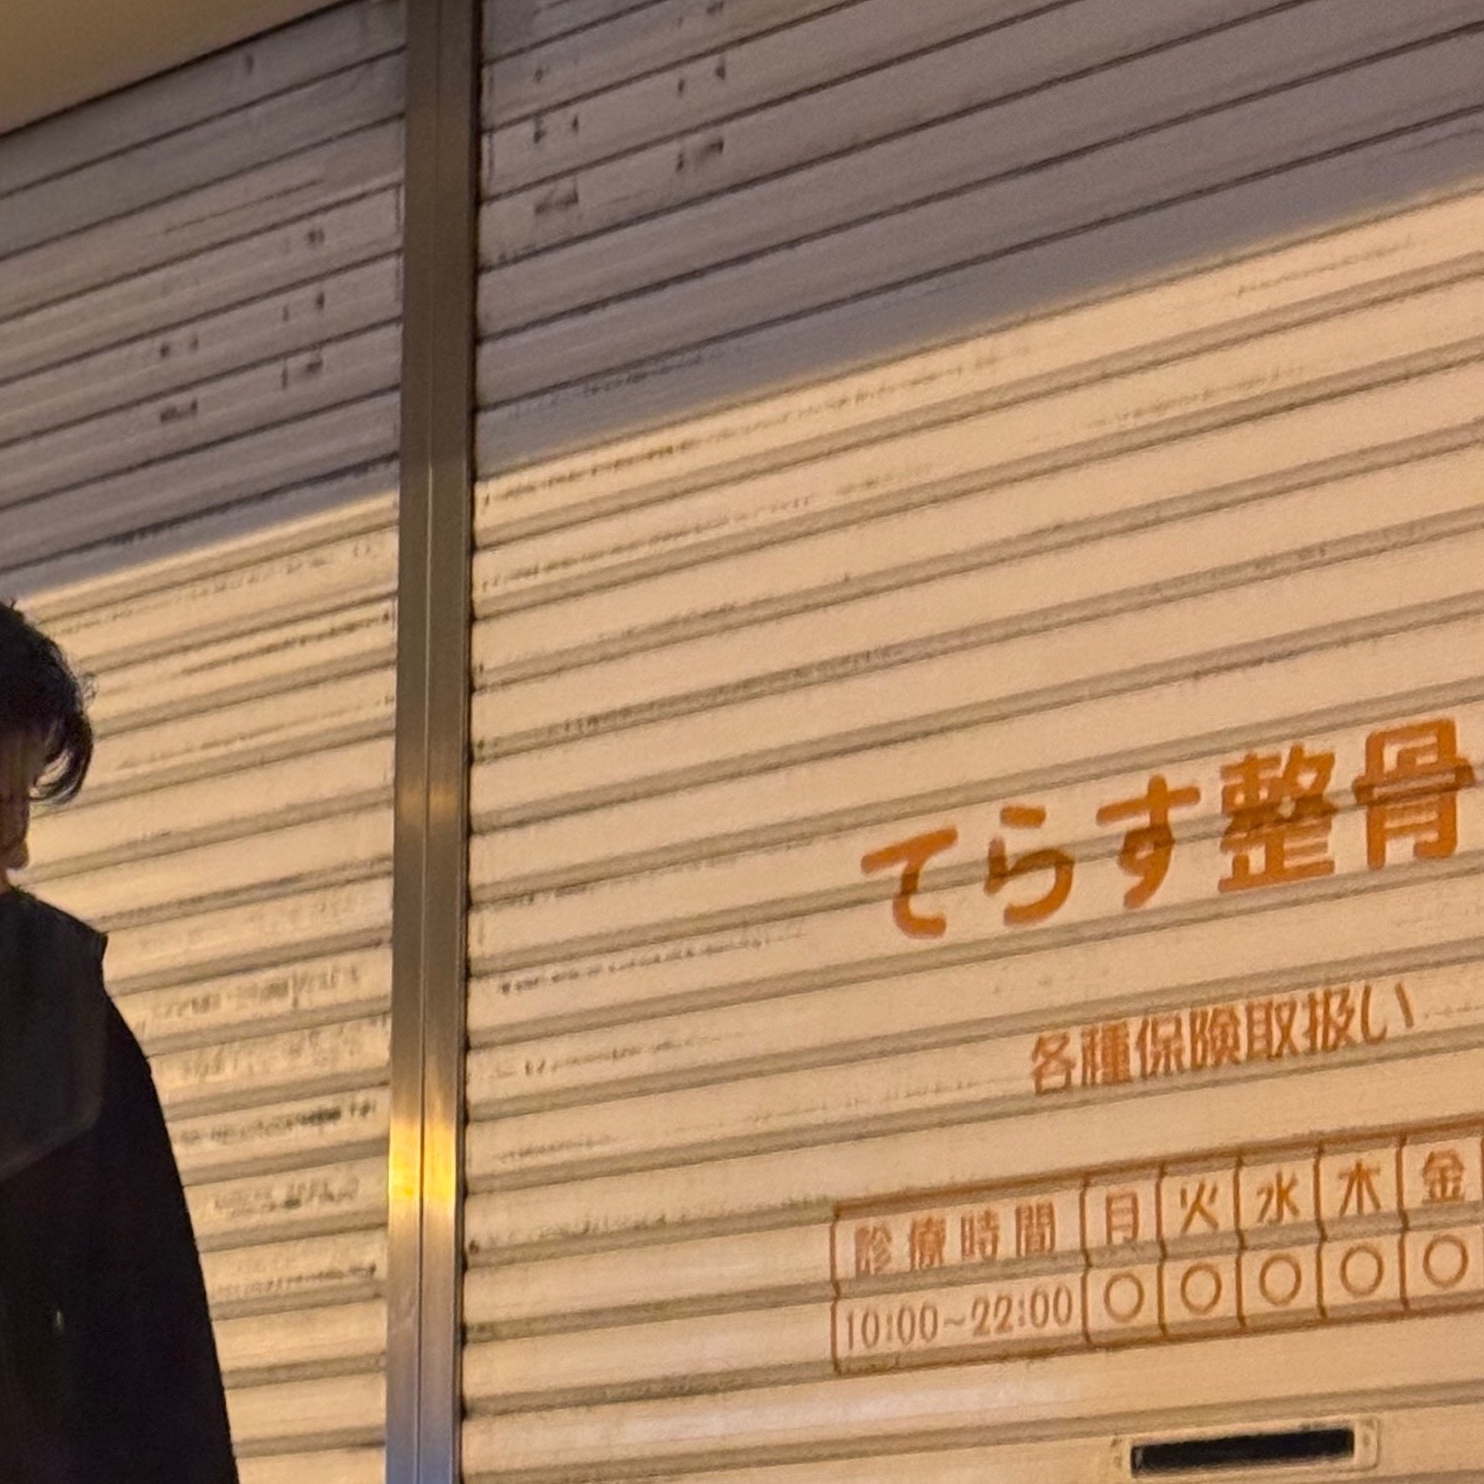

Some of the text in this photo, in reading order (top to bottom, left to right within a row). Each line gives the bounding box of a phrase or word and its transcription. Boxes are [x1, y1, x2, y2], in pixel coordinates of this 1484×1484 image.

[861, 717, 1475, 939] てらす整骨
[1031, 982, 1414, 1096] 各種保険取扱い
[1104, 1189, 1140, 1246] 月
[1180, 1179, 1219, 1235] 火
[1256, 1168, 1300, 1224] 水
[1338, 1159, 1383, 1217] 木
[1421, 1148, 1466, 1205] 金
